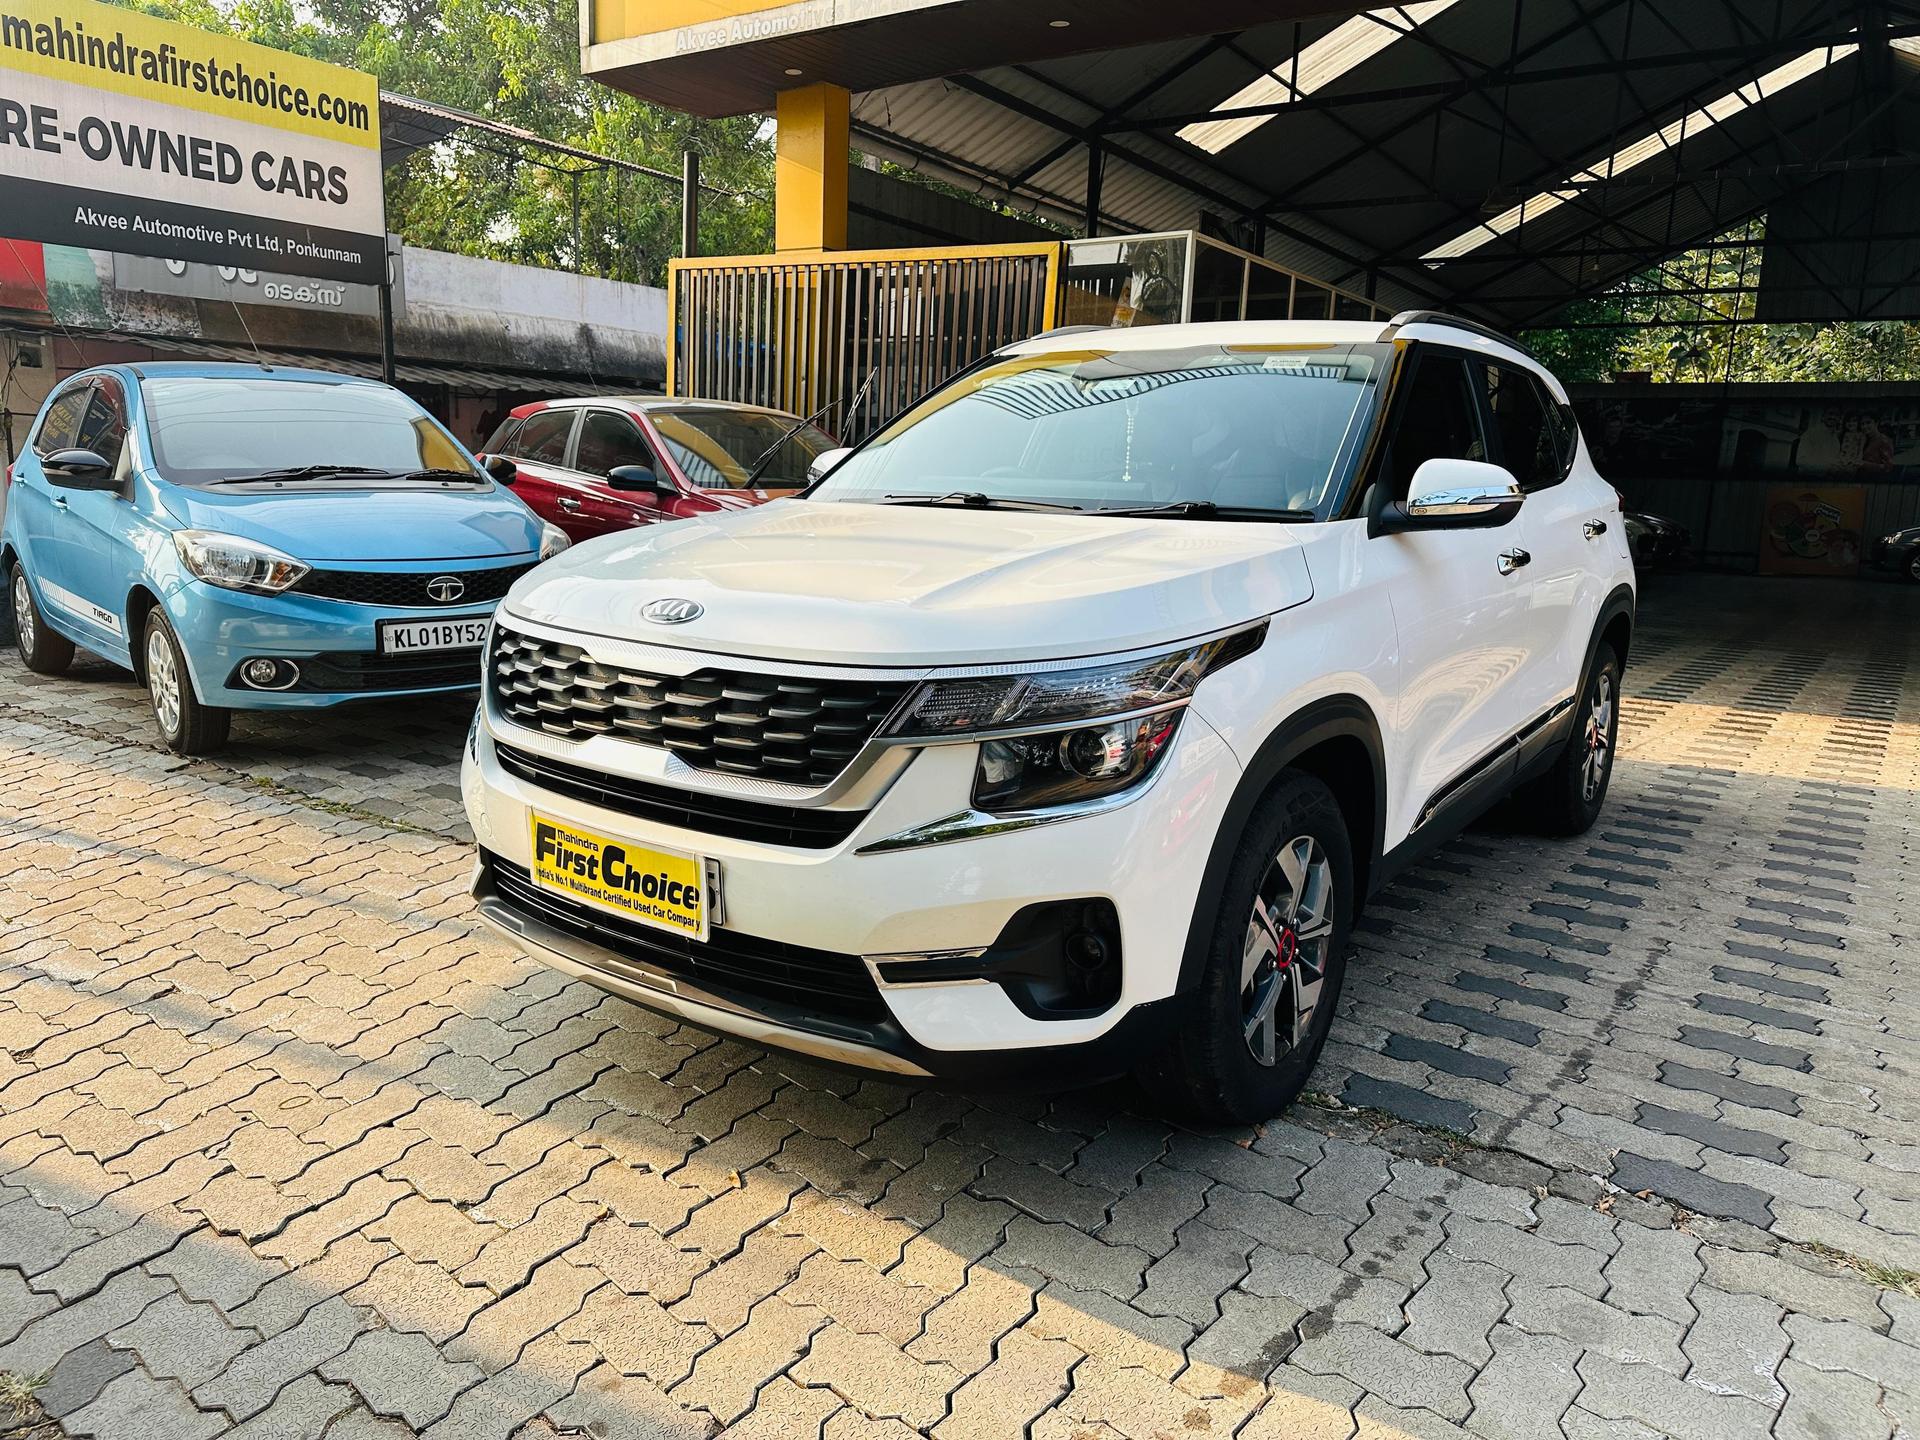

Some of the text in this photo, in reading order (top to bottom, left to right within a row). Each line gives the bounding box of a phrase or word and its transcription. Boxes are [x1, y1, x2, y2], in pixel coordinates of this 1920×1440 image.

[676, 28, 727, 53] Akvee
[1, 13, 369, 131] mahindrafirstchoice.com
[0, 97, 349, 205] RE-OWNED CARS
[74, 206, 362, 264] Akvee Automotive Pvt Ltd, Ponkunnam
[92, 607, 113, 624] TIAGO
[536, 822, 700, 910] First Choice
[556, 829, 599, 852] Mahindra
[555, 873, 569, 886] No.1
[569, 878, 602, 899] Multibrand
[602, 889, 632, 908] Certified
[633, 899, 651, 914] Used
[652, 905, 665, 919] Car
